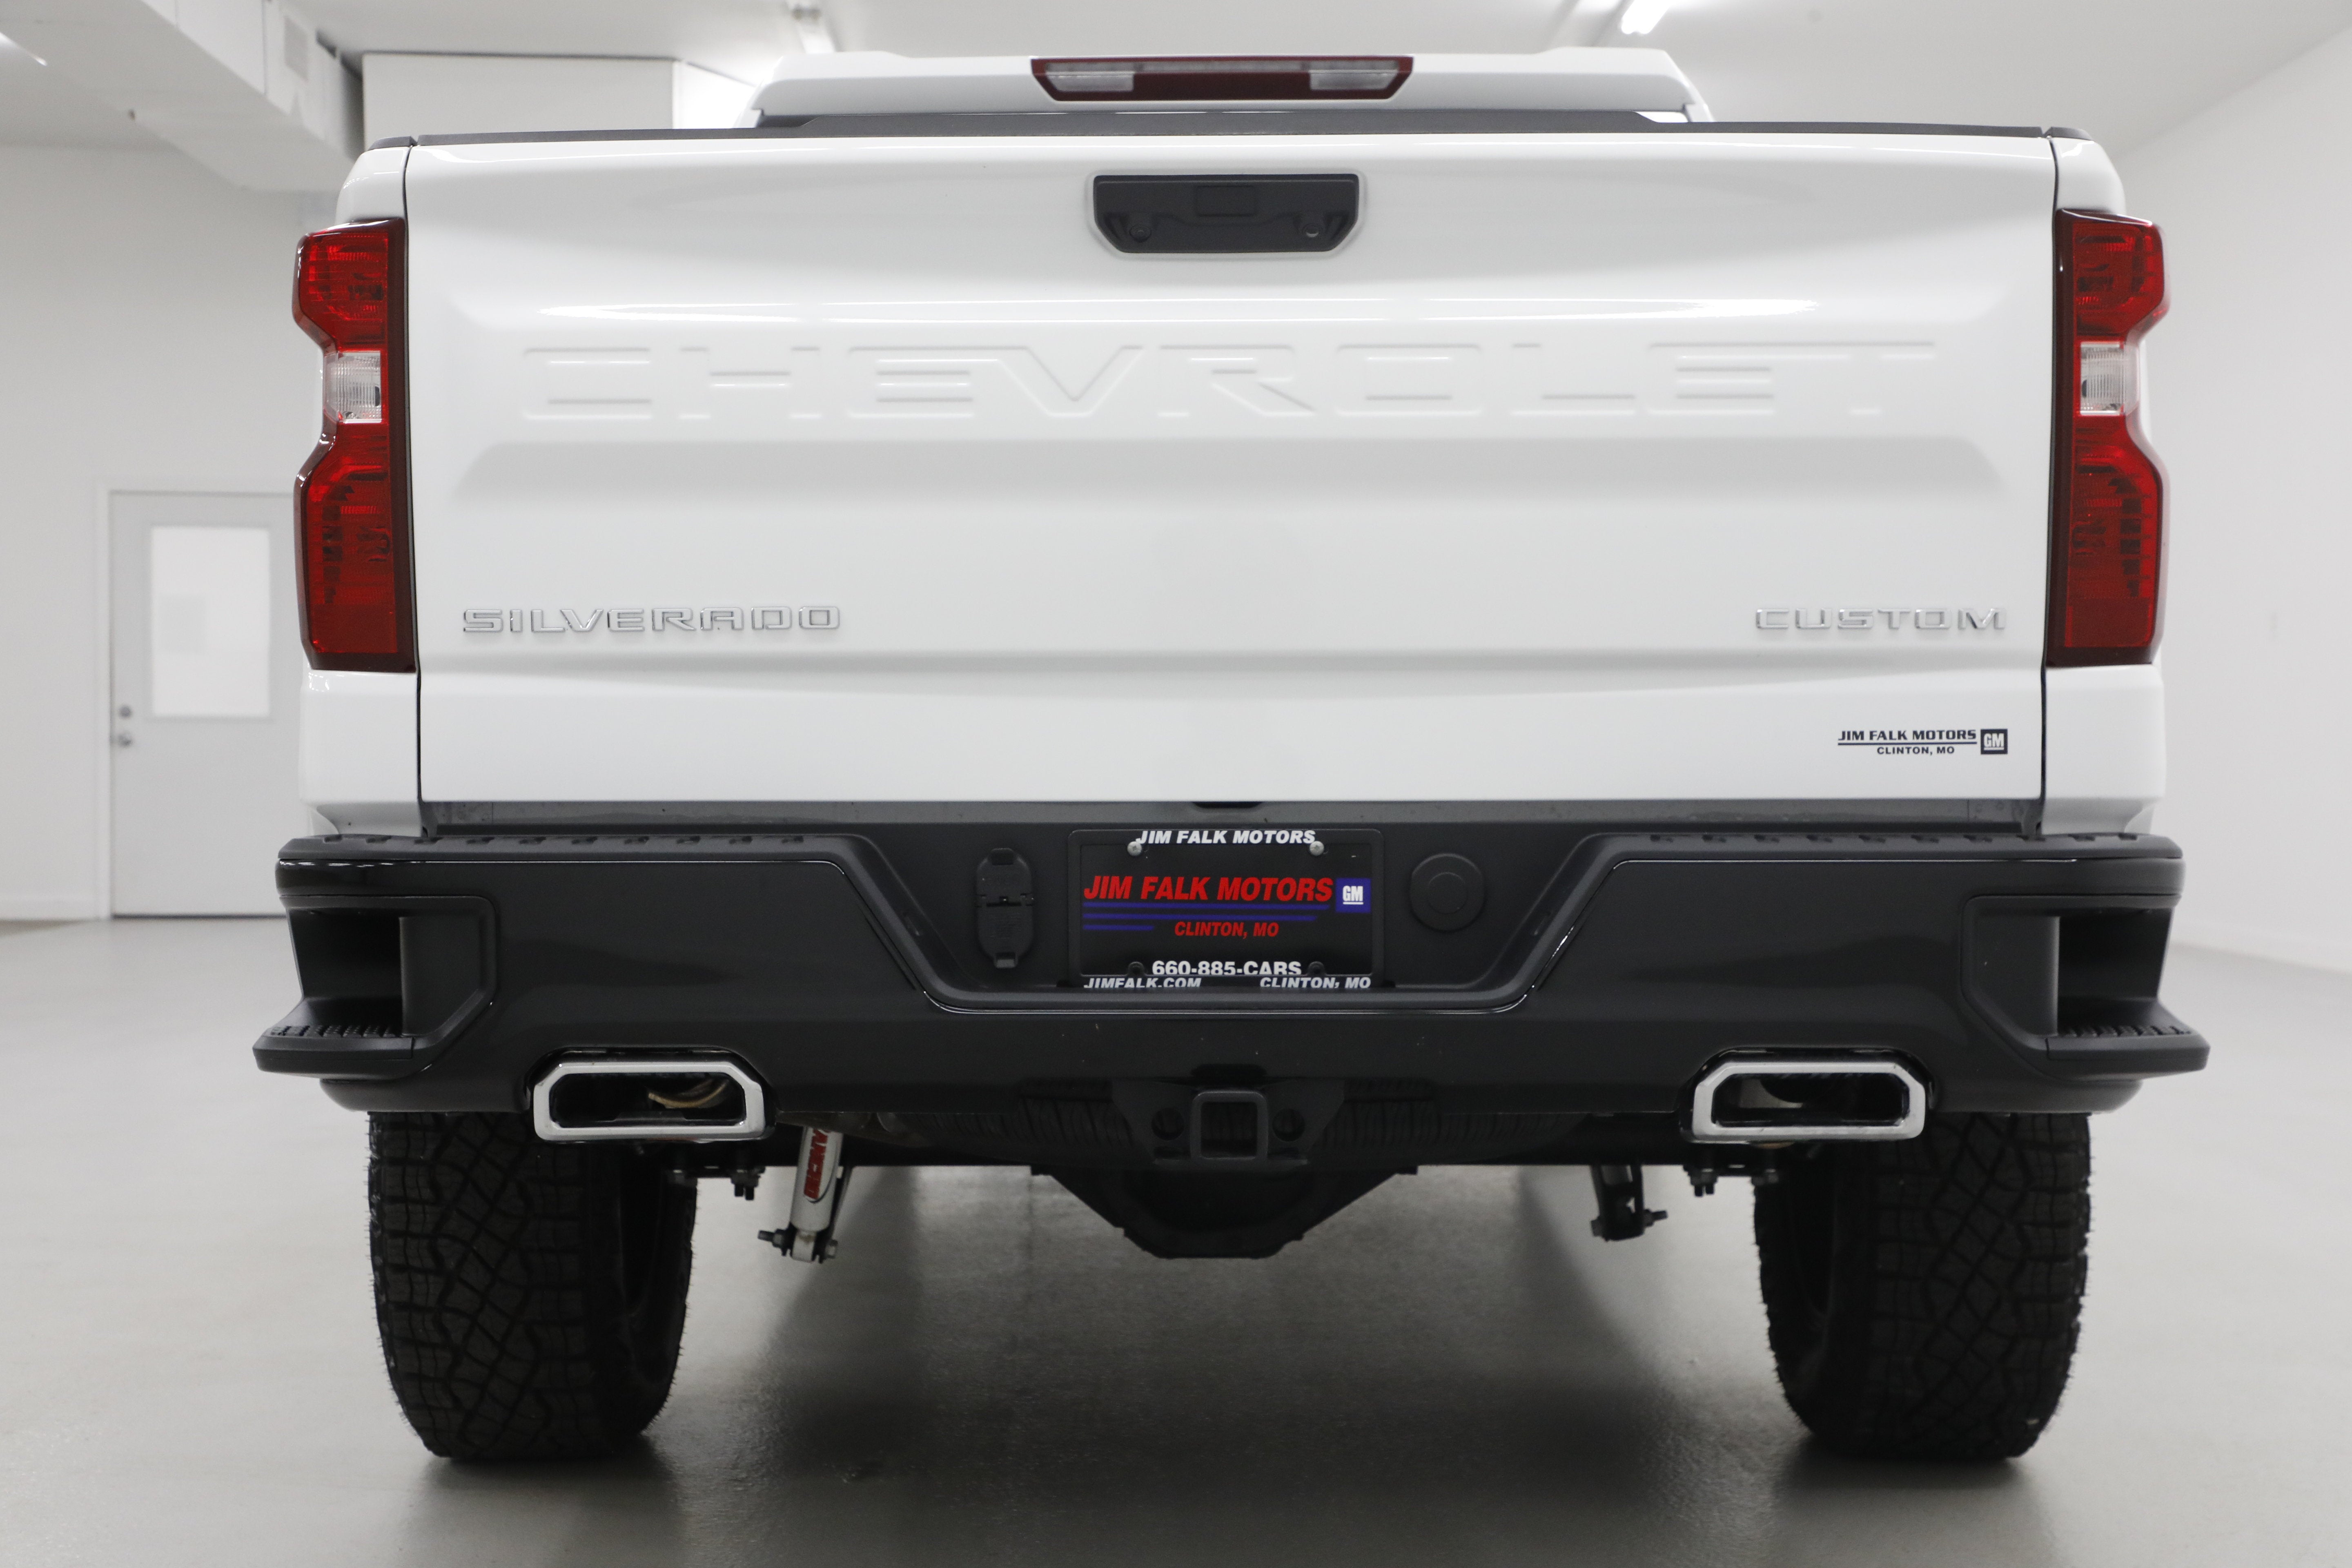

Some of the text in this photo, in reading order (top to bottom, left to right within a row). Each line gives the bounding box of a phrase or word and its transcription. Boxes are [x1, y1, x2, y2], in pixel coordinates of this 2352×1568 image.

[523, 341, 1938, 417] CHEVROLET
[463, 606, 840, 633] SILVERADO
[1755, 608, 2007, 630] CUSTOM
[1838, 730, 1976, 741] JIM FALK MOTORS
[1984, 733, 2005, 748] GM
[1877, 746, 1933, 755] CLINTON,
[1135, 830, 1316, 844] JIM FALK MOTORS
[1083, 875, 1334, 902] JIM FALK MOTORS
[1343, 885, 1364, 902] GM
[1174, 922, 1279, 939] CLINTON, MO
[1152, 960, 1302, 975] 660-885-CARS
[1083, 978, 1202, 989] JIMFALK.COM
[1260, 977, 1371, 989] CLINTON, MO
